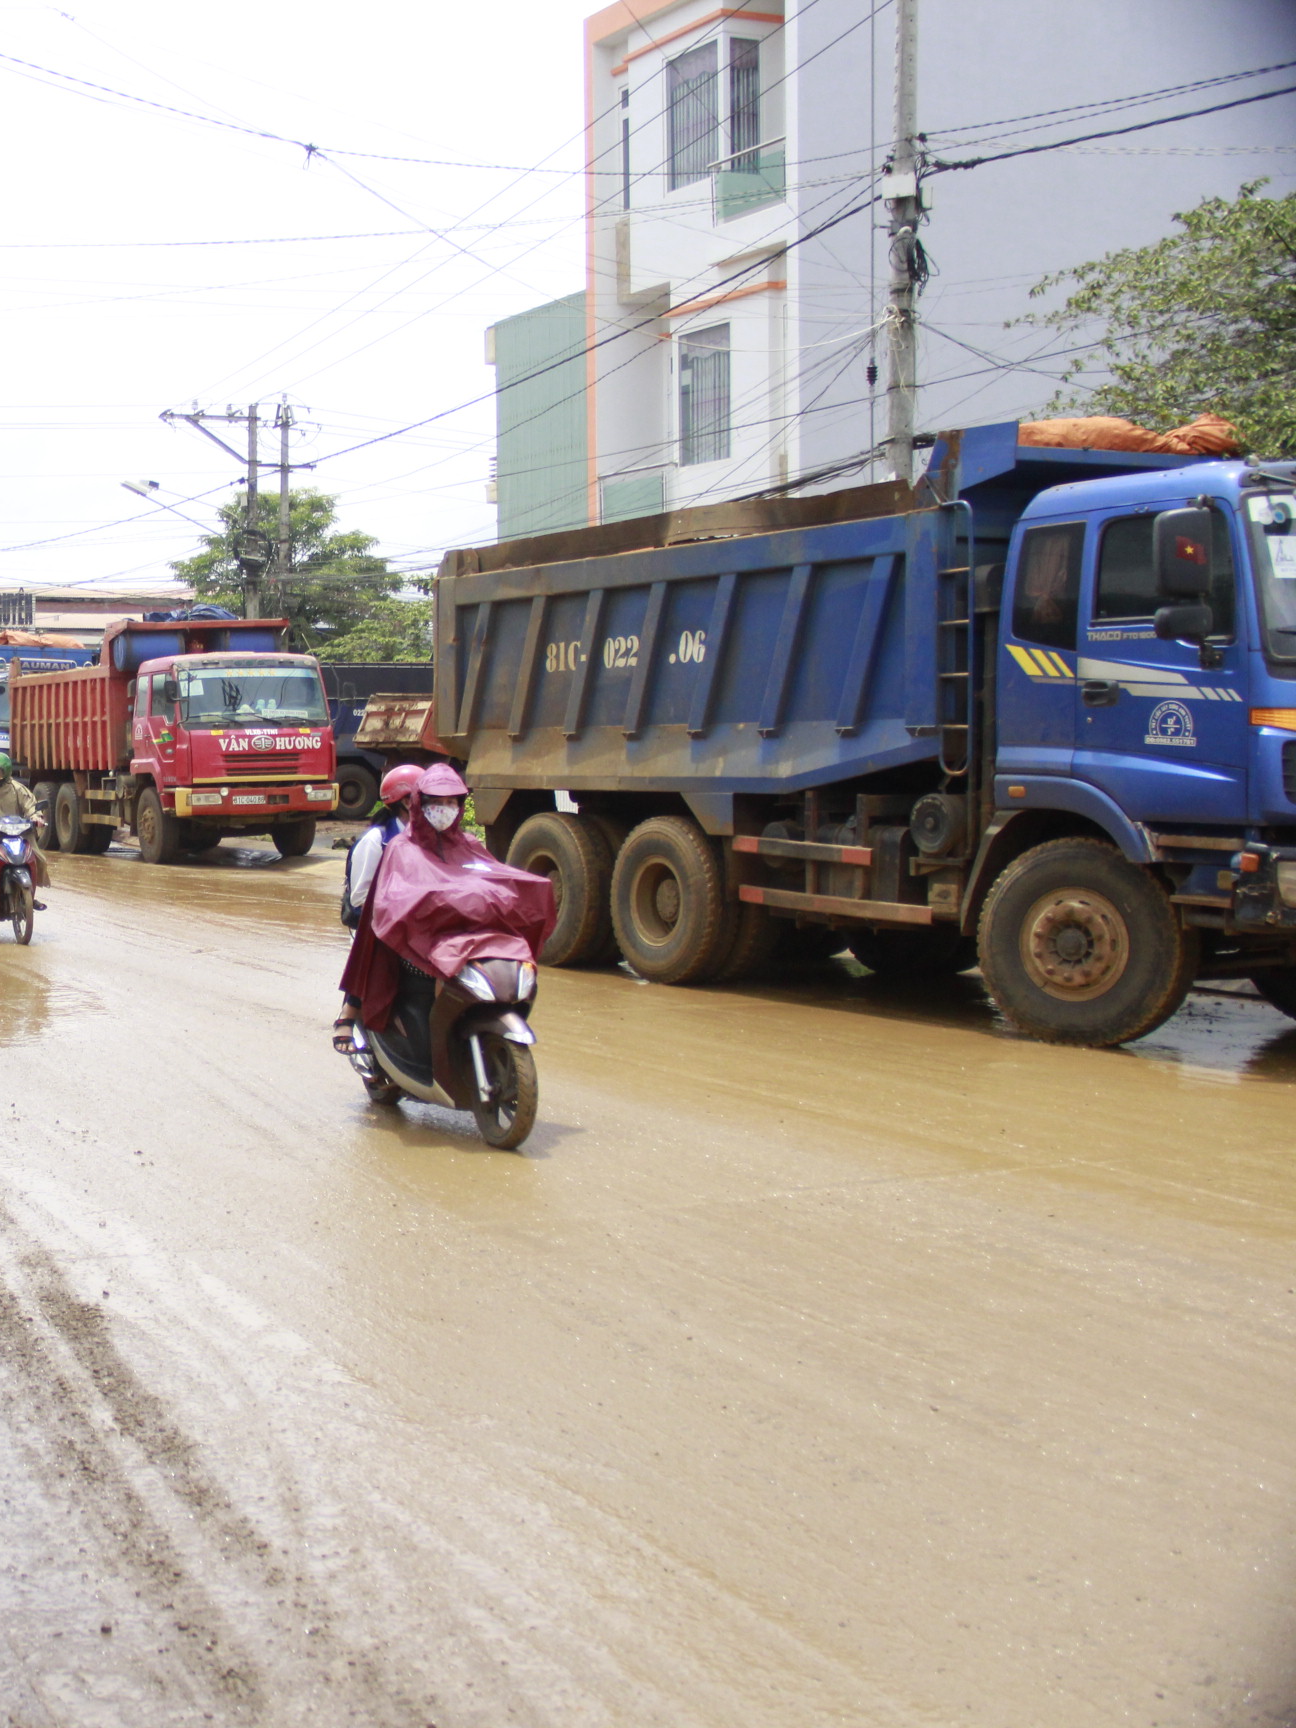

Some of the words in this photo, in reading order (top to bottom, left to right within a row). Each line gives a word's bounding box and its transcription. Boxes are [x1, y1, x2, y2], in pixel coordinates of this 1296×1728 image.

[1087, 631, 1121, 641] THACO
[604, 635, 640, 668] 022
[22, 661, 70, 670] AUMAN
[219, 735, 249, 751] VÂN
[275, 736, 322, 750] HƯƠNG
